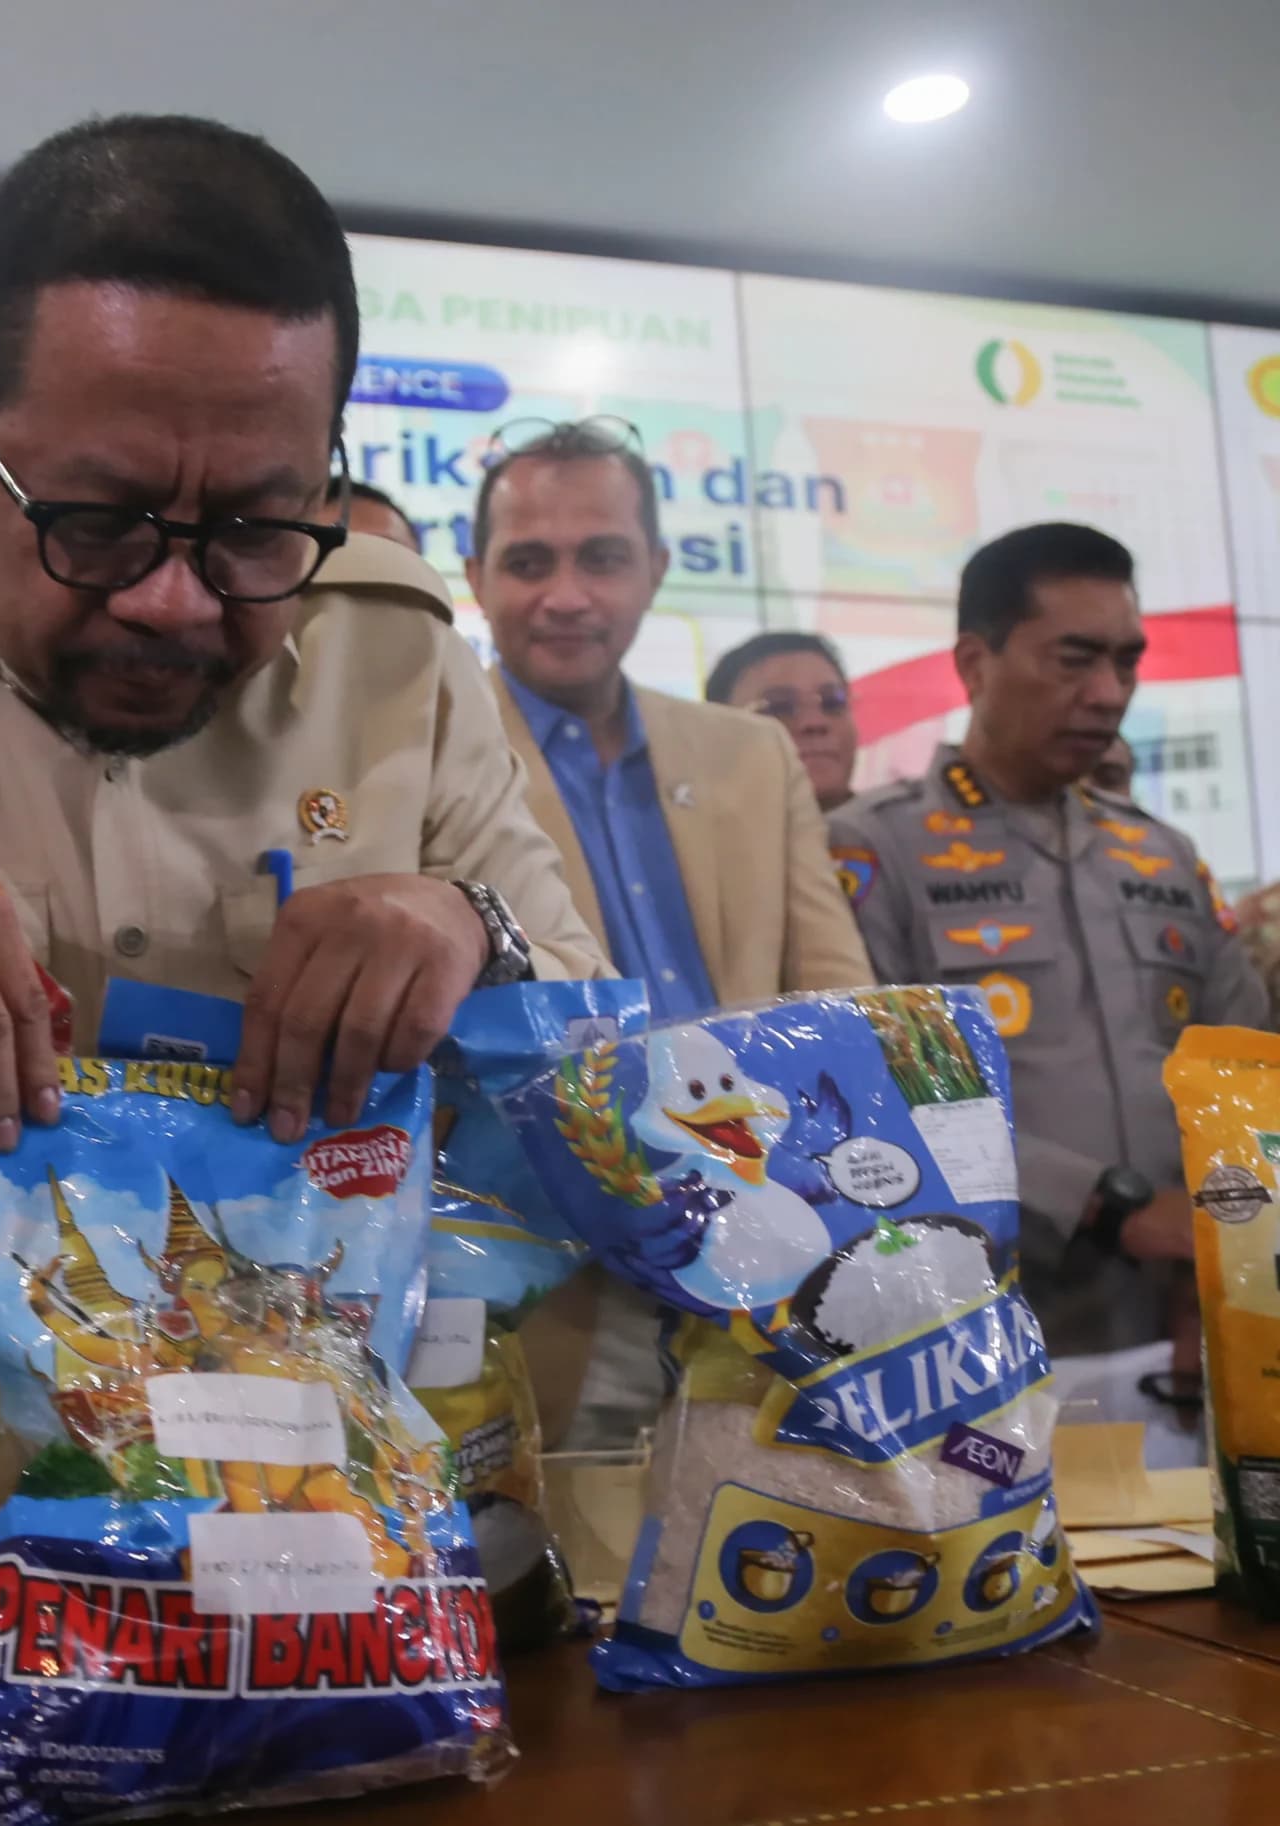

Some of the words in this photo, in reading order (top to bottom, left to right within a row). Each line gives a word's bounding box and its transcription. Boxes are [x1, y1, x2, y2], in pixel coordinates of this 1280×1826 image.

[360, 363, 465, 402] ENCE
[701, 453, 848, 512] dan
[926, 880, 1026, 907] WAHYU
[57, 1057, 110, 1097] AS
